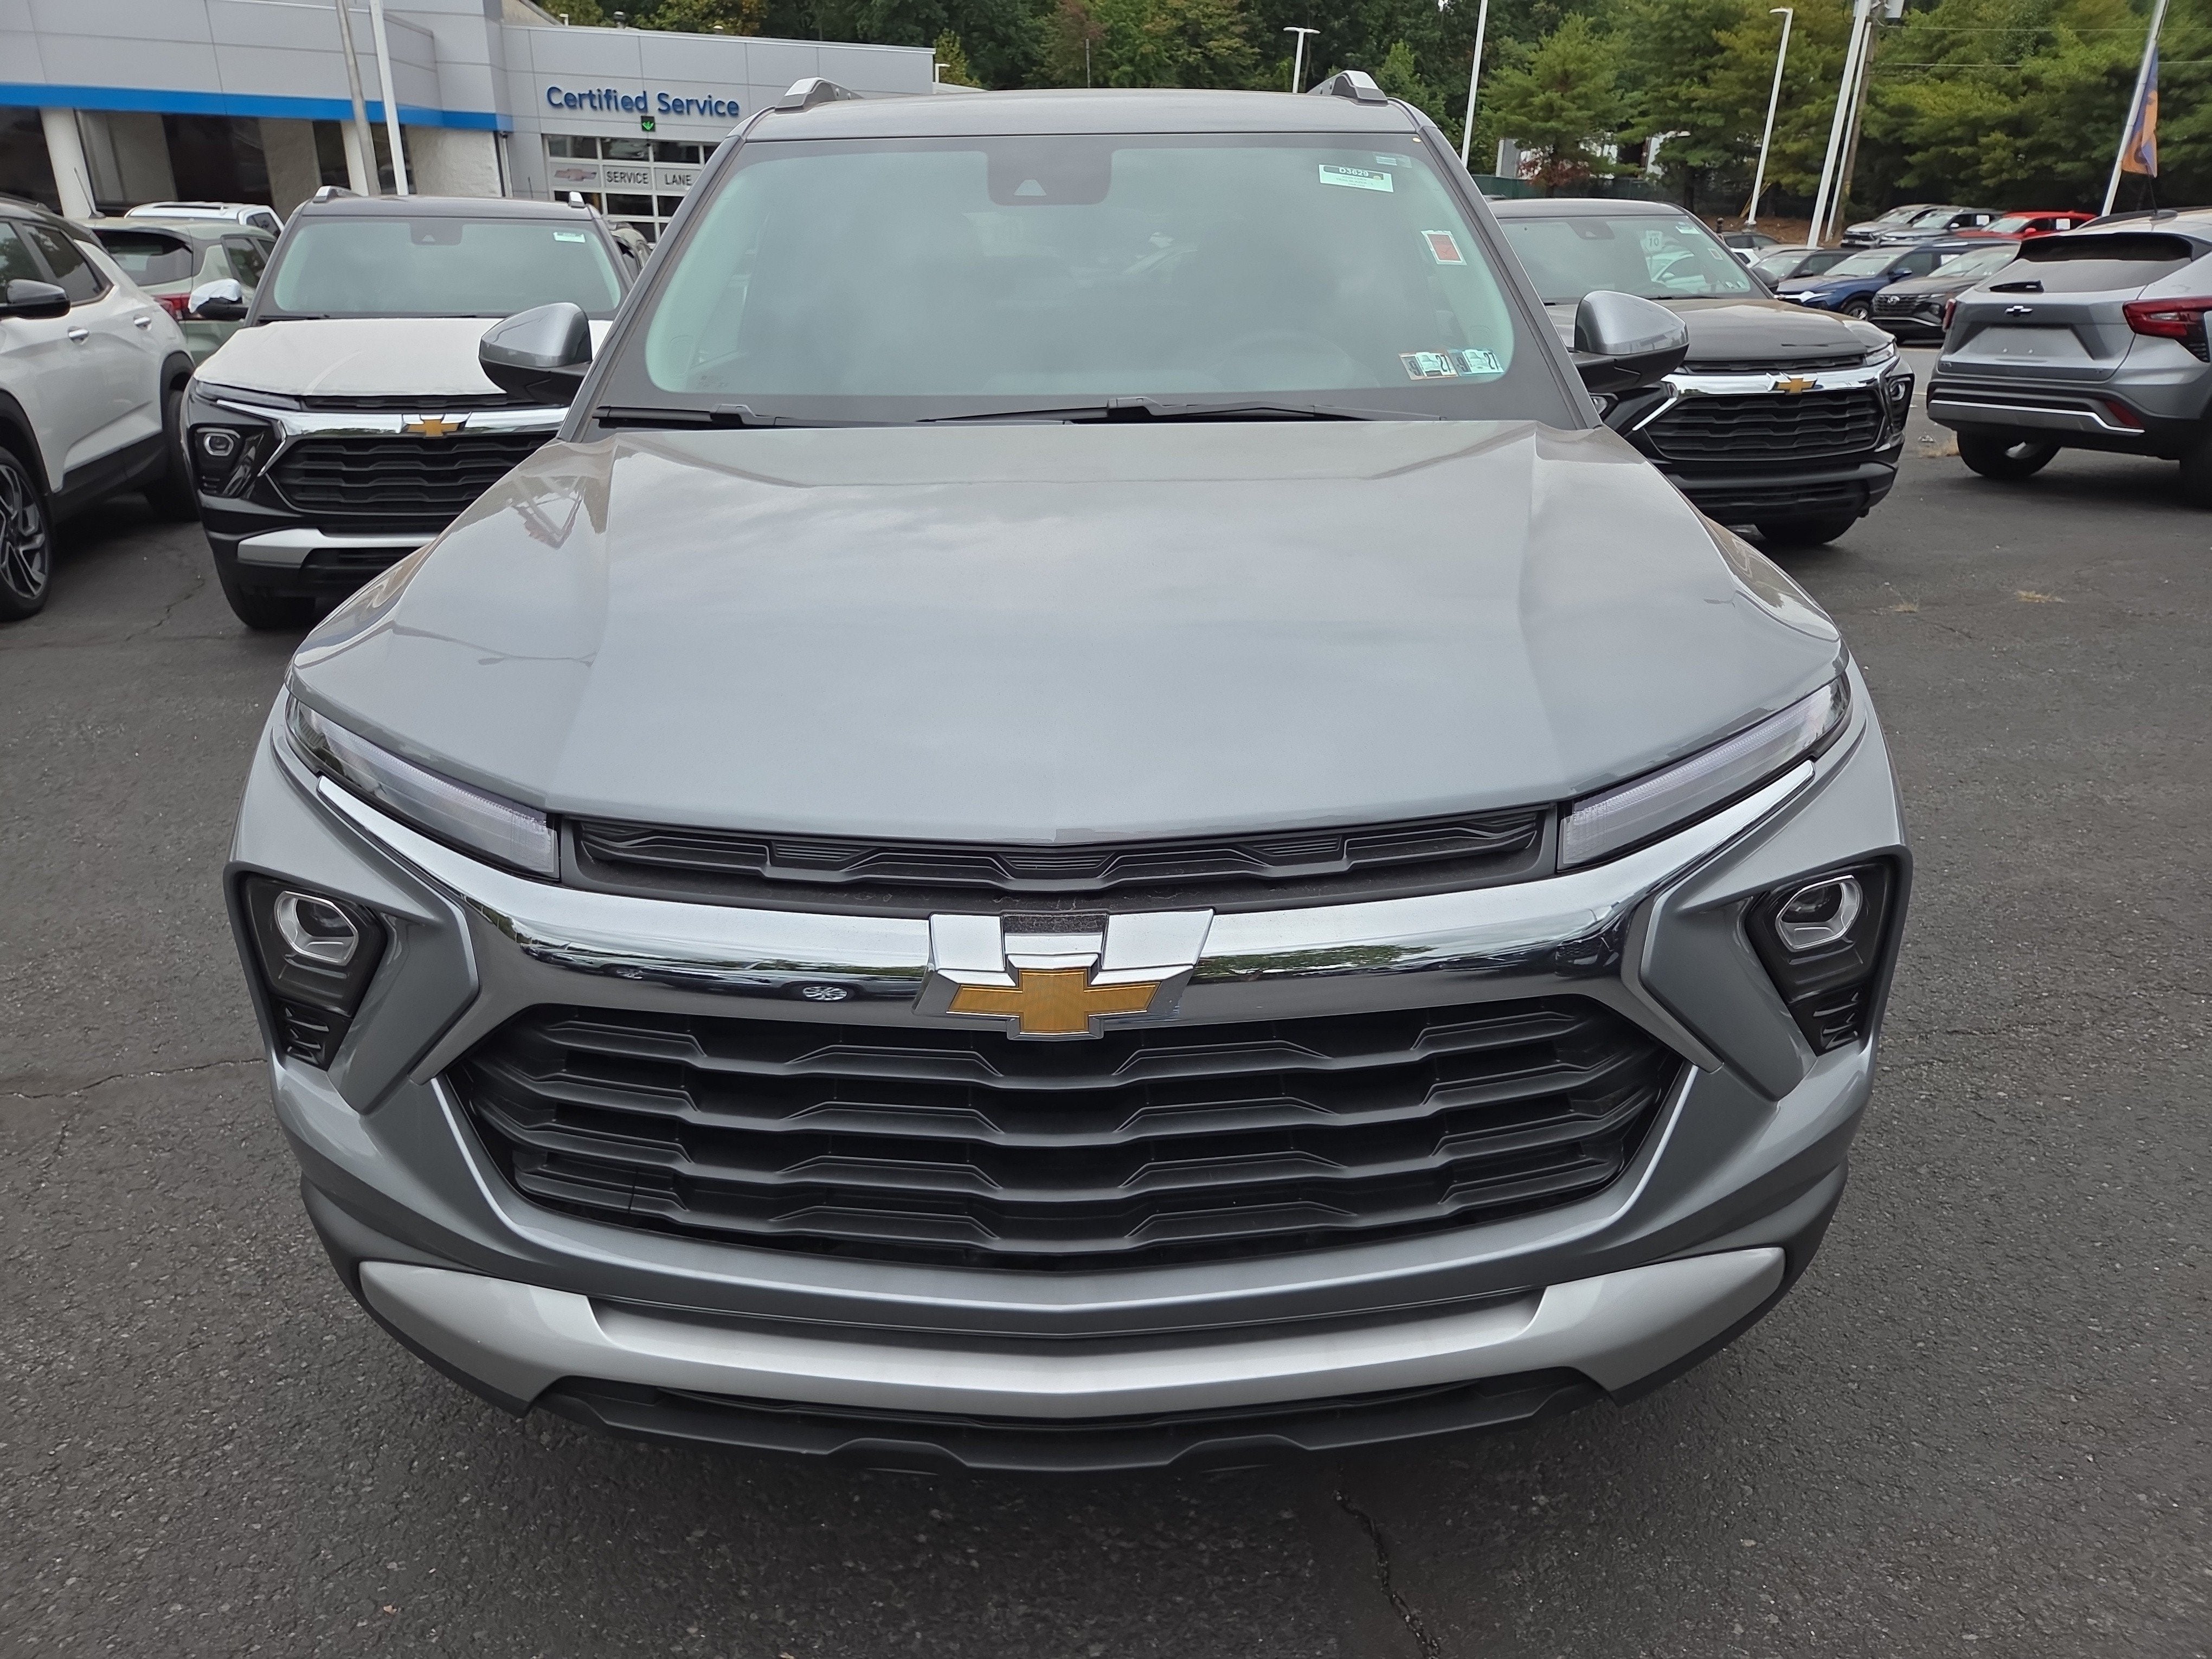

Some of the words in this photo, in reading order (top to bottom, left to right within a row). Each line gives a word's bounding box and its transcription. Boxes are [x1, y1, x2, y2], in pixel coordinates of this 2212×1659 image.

[546, 86, 648, 113] Certified
[657, 92, 740, 118] Service
[606, 170, 650, 185] SERVICE
[664, 173, 692, 187] LANE
